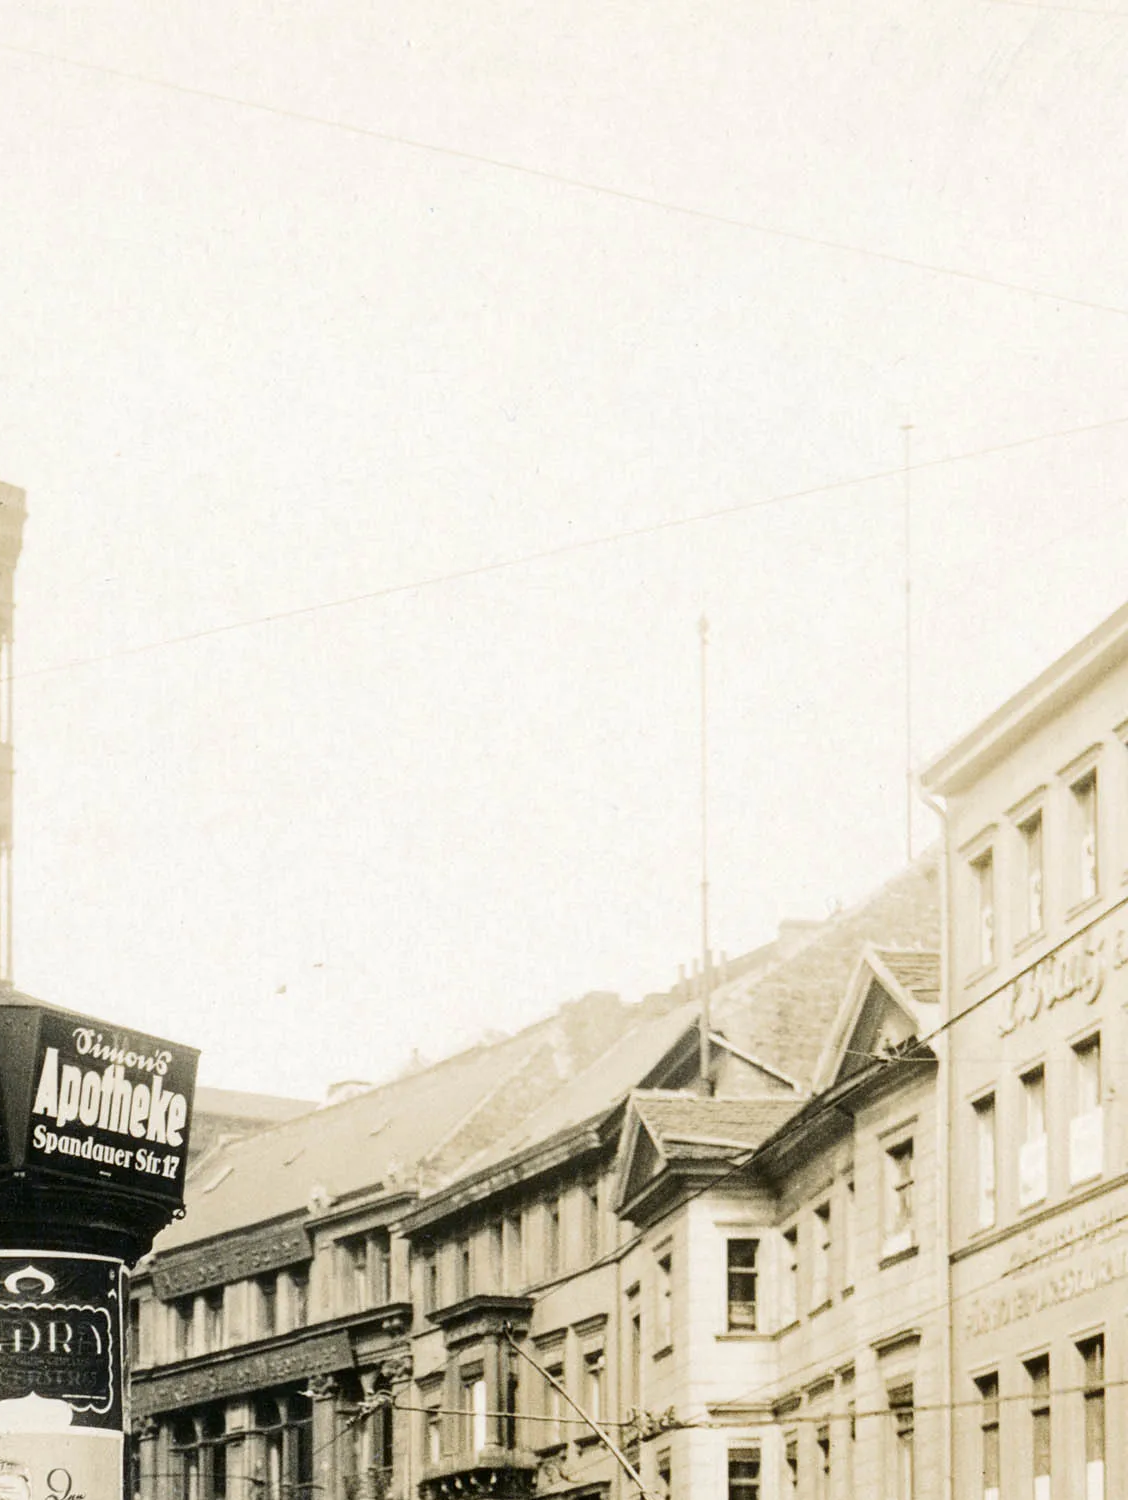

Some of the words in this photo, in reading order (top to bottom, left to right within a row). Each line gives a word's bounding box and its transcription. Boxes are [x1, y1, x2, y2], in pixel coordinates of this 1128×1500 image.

[32, 1046, 187, 1147] Apotheke
[32, 1123, 134, 1168] Spandauer
[162, 1154, 181, 1180] 17
